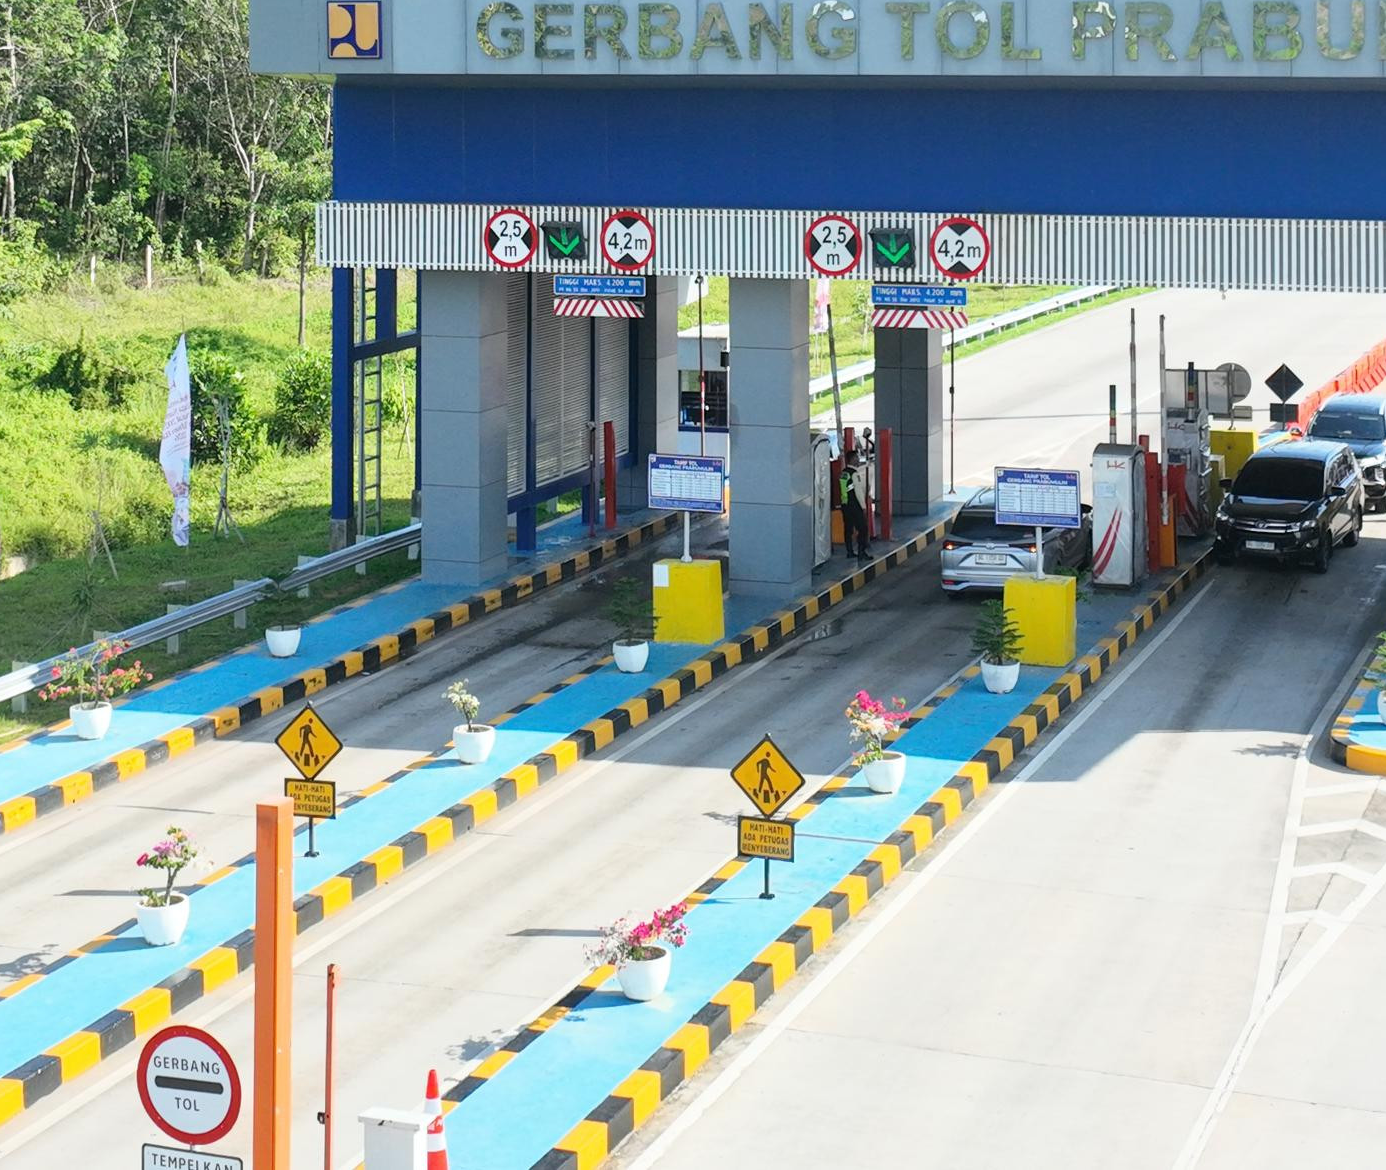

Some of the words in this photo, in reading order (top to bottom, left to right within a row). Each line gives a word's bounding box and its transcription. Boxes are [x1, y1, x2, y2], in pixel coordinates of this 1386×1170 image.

[499, 220, 522, 242] 2,5
[822, 226, 847, 249] 2,5
[504, 245, 517, 257] m
[826, 253, 840, 266] m
[749, 823, 784, 834] HATI-HATI
[744, 832, 756, 841] ADA
[760, 834, 790, 845] PETUGAS
[153, 1055, 221, 1075] GERBANG
[175, 1097, 201, 1112] TOL
